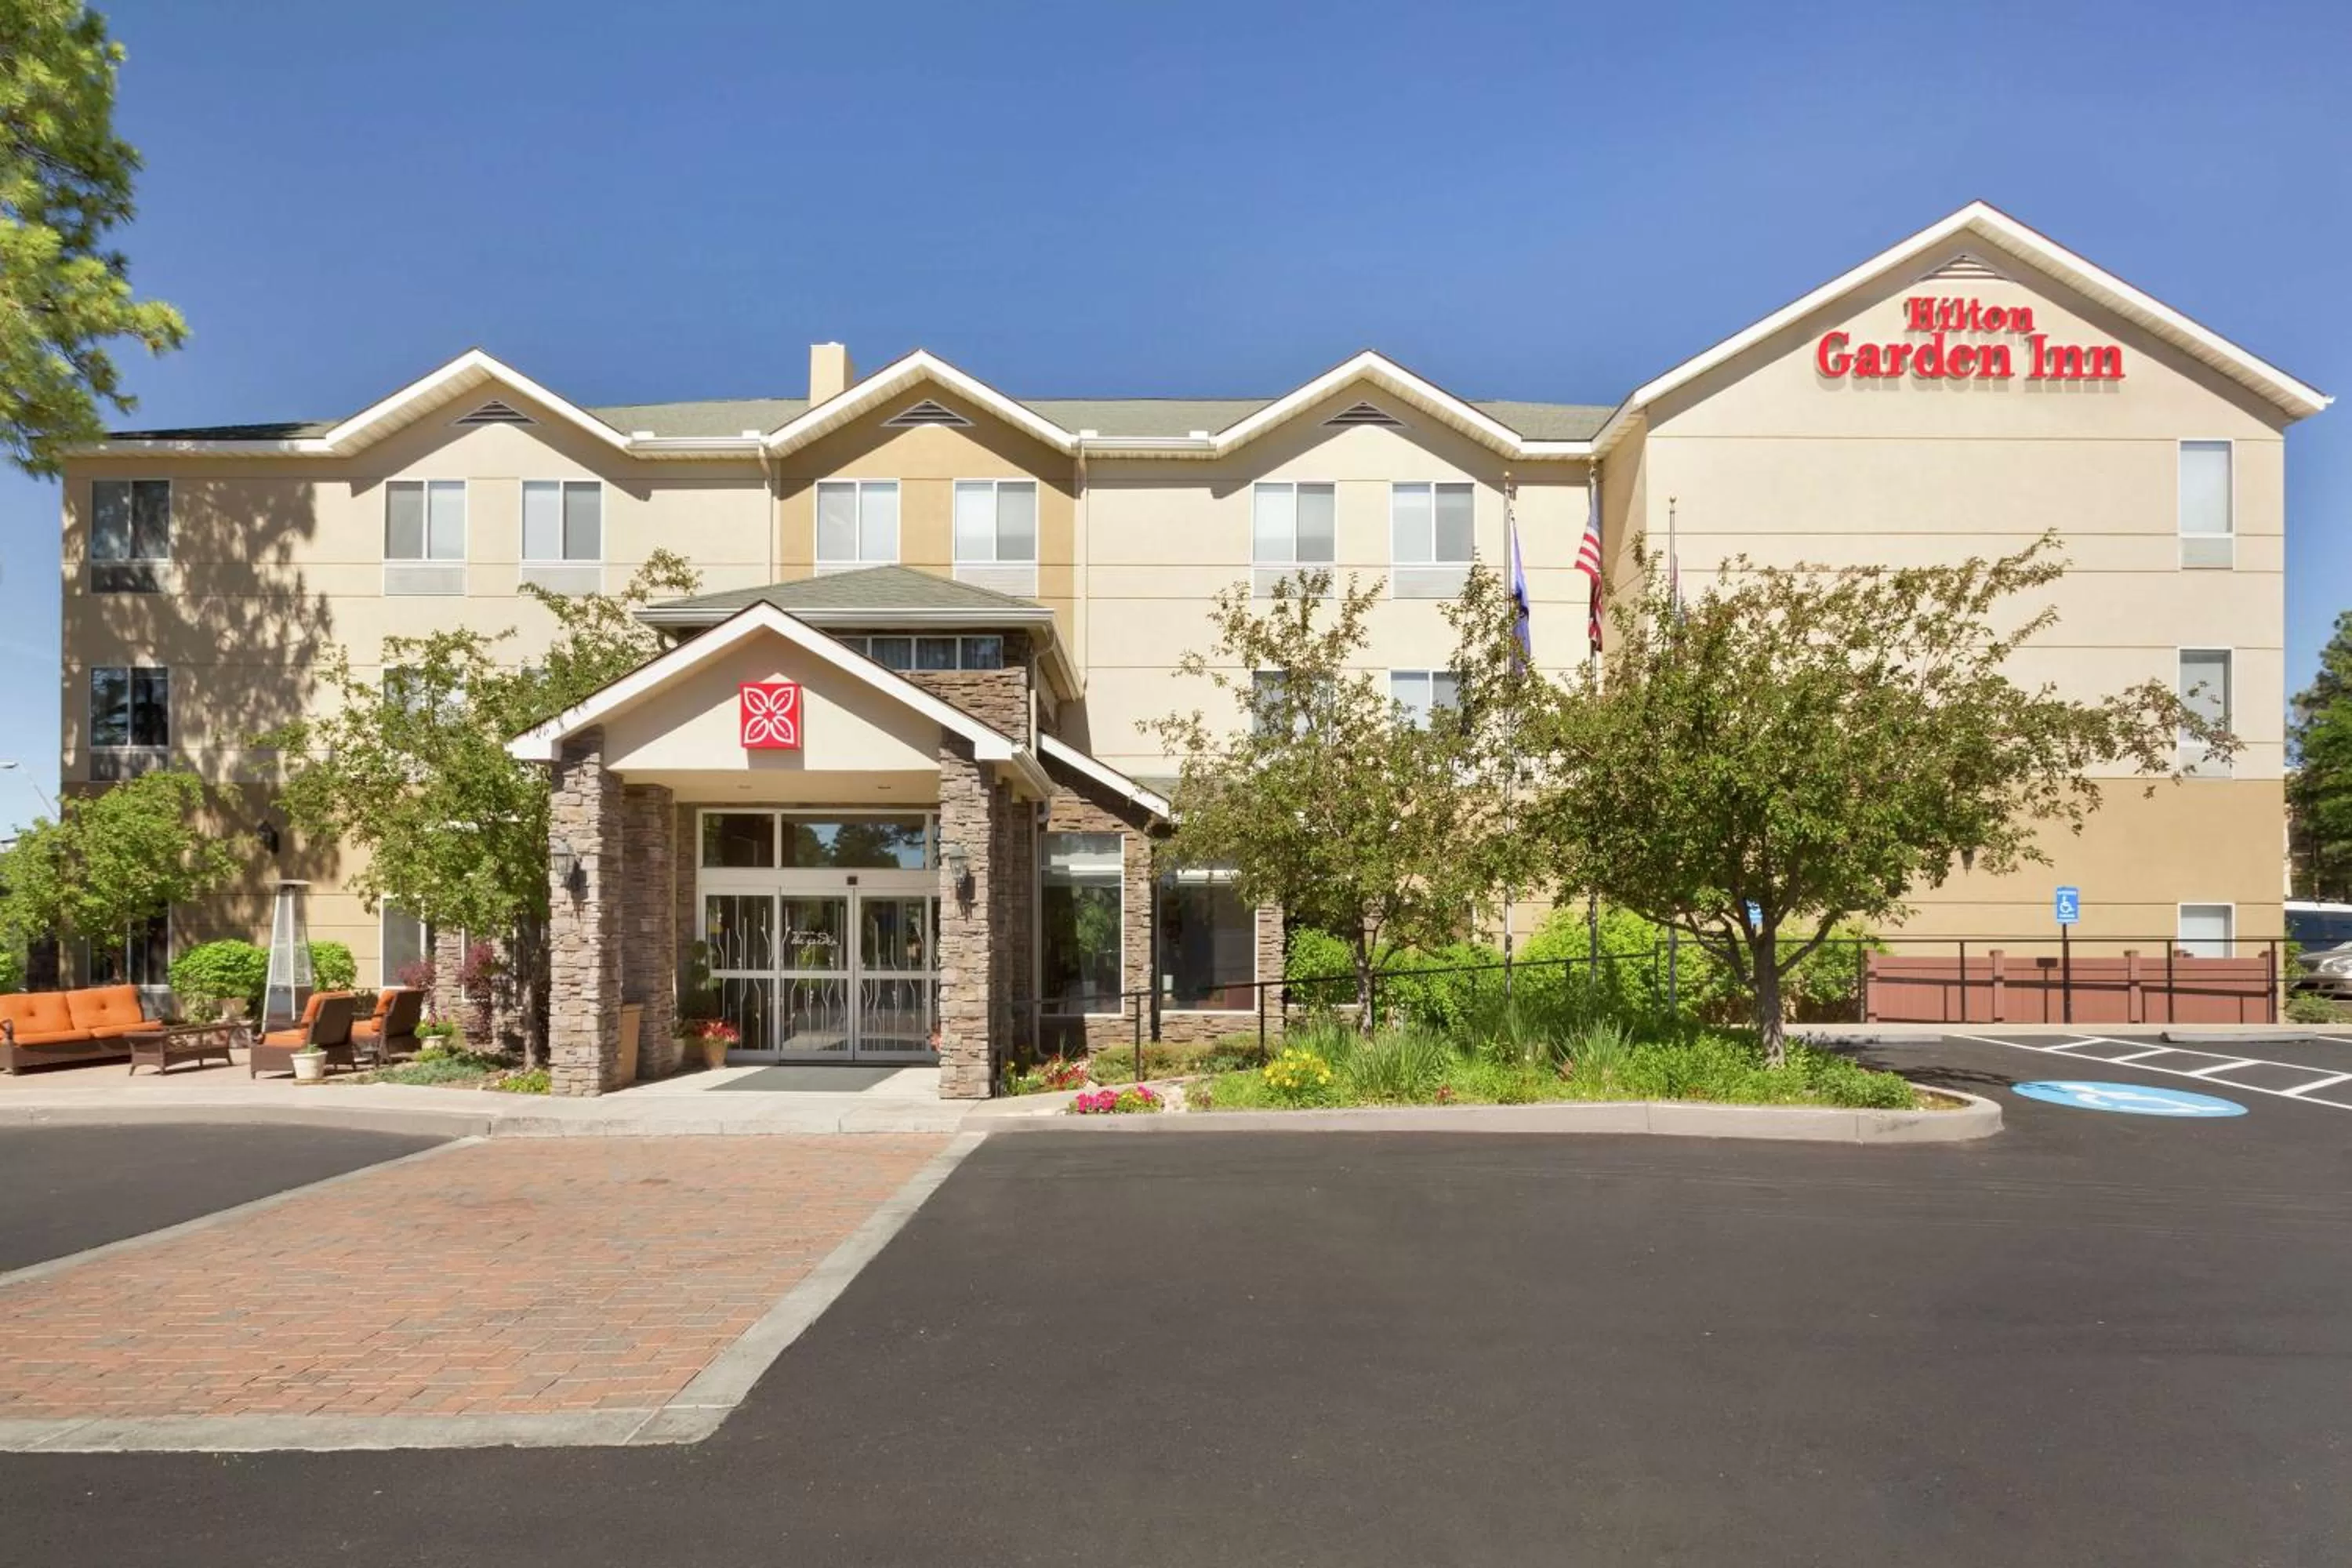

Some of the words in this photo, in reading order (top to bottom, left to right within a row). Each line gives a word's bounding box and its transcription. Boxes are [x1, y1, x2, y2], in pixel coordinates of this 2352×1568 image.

[1905, 296, 2035, 332] Hilton
[1817, 331, 2015, 378] Garden
[2025, 333, 2126, 379] Inn
